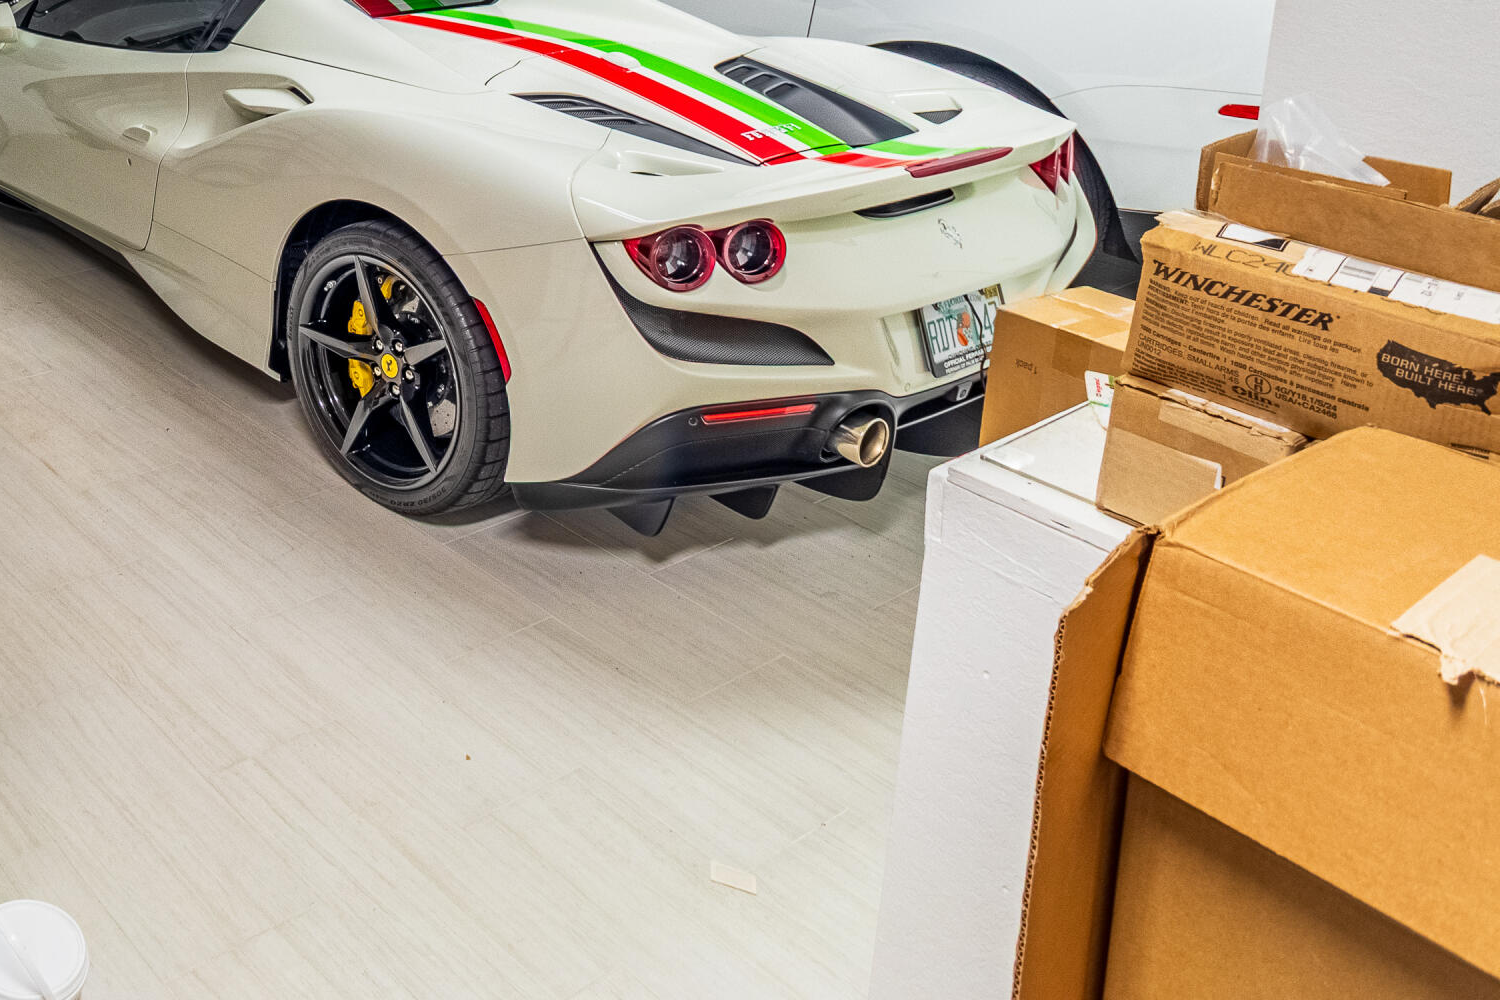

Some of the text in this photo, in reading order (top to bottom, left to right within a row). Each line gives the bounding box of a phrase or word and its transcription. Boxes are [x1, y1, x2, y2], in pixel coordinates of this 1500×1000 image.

[1152, 259, 1334, 332] WINCHESTER
[1264, 318, 1280, 328] Read
[1186, 353, 1213, 368] SMALL
[1214, 363, 1239, 377] ARMS
[1381, 353, 1421, 373] BORN
[1395, 369, 1434, 386] BUILT
